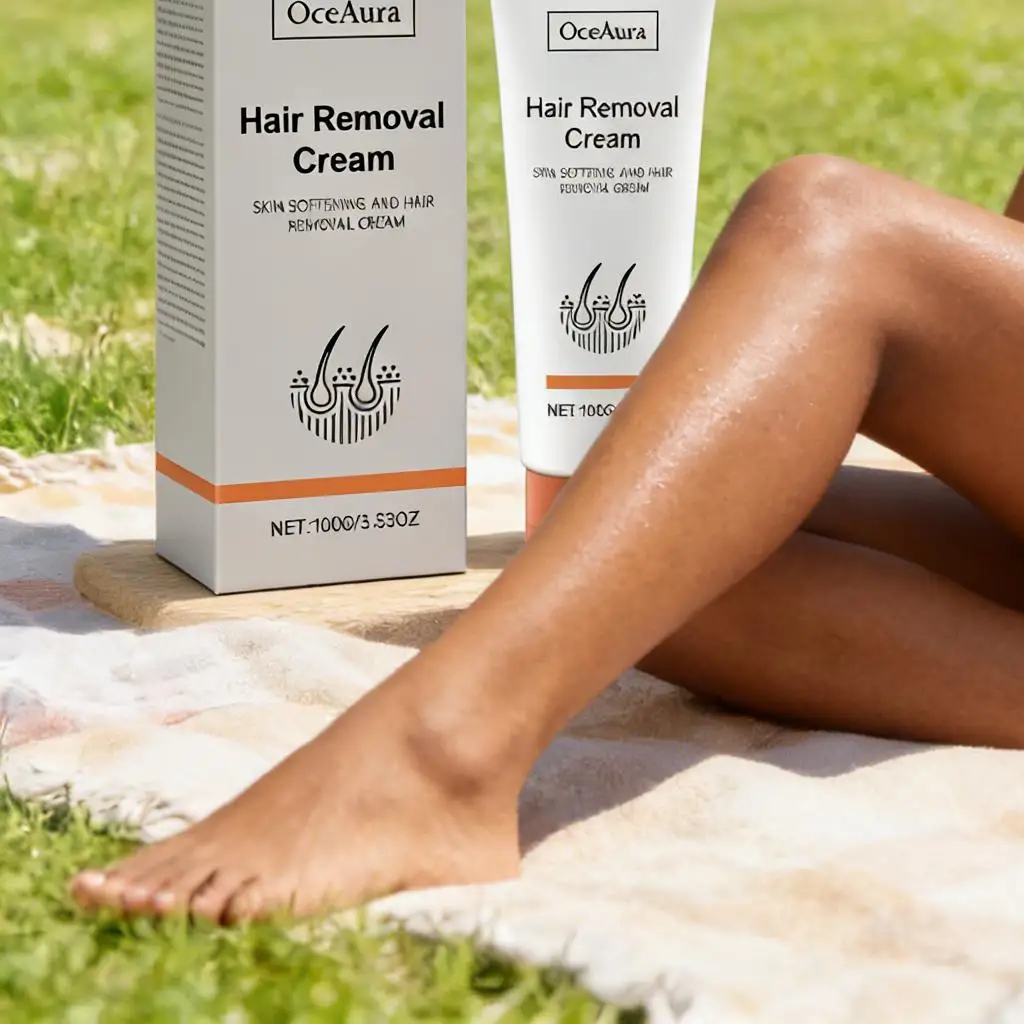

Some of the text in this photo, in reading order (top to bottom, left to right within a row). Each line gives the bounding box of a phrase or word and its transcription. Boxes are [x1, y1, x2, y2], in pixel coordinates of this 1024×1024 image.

[287, 0, 402, 25] OceAura
[559, 20, 647, 41] OceAura
[240, 101, 445, 135] Hair Removal
[526, 94, 679, 119] Hair Removal
[564, 127, 641, 149] Cream
[292, 145, 395, 175] Cream
[252, 199, 285, 215] SKIN
[371, 196, 400, 210] AND
[403, 194, 435, 210] HAIR
[547, 403, 575, 417] NET
